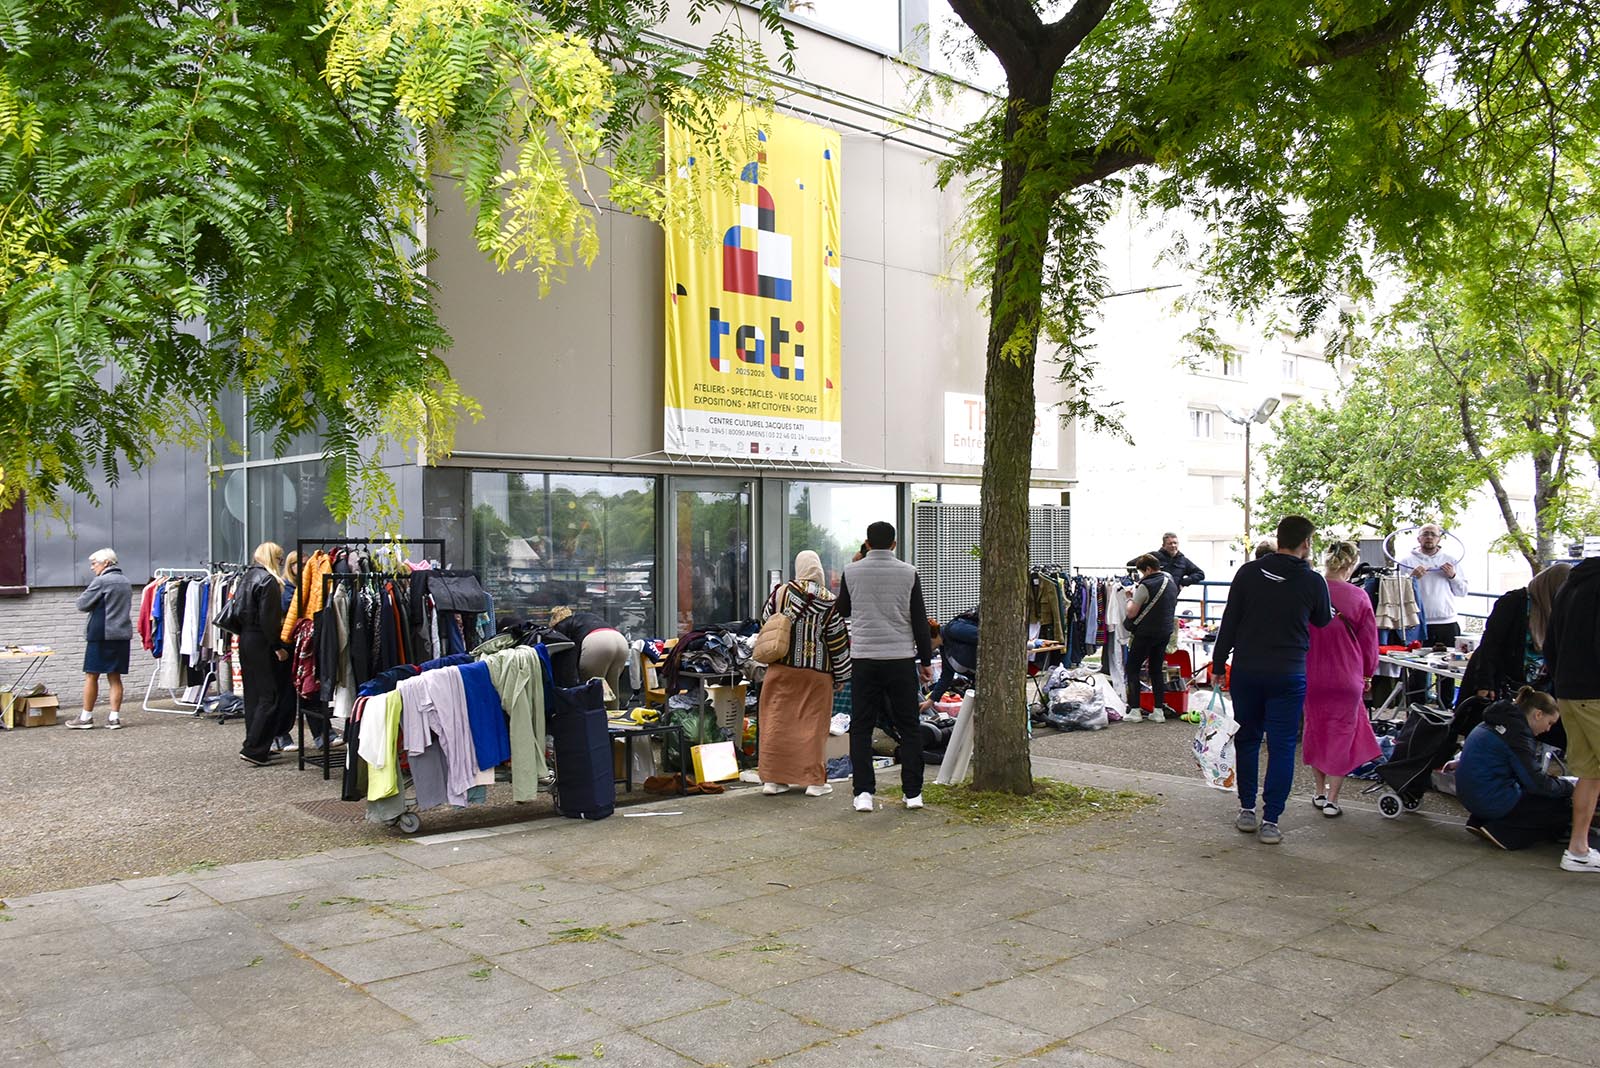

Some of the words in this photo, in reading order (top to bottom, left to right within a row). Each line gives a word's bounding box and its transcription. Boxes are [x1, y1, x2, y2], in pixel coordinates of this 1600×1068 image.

[709, 307, 805, 381] tati
[694, 383, 725, 394] ATELIERS
[731, 387, 773, 399] SPECTACLES
[778, 391, 789, 400] VIE
[790, 394, 817, 403] SOCIALE
[694, 396, 741, 408] EXPOSITIONS
[747, 401, 760, 409] ART
[761, 402, 791, 412] CITOYEN
[796, 405, 817, 414] SPORT
[709, 416, 733, 426] CENTRE
[734, 419, 764, 428] CULTUREL
[765, 421, 792, 430] JACQUES
[793, 423, 805, 431] TATI
